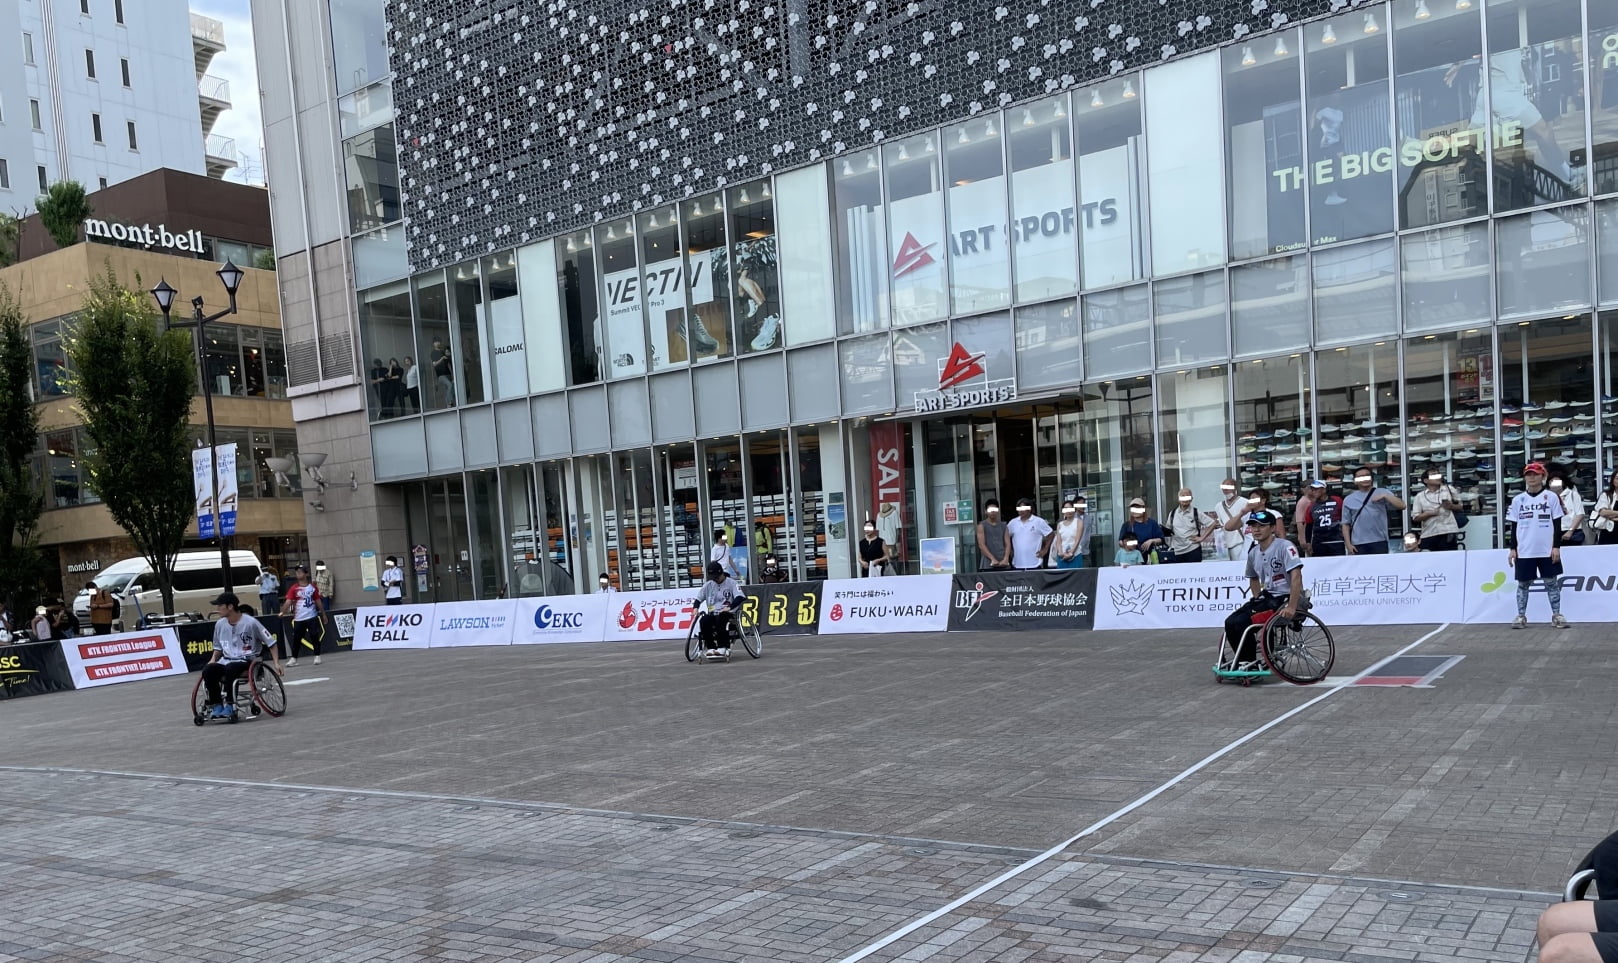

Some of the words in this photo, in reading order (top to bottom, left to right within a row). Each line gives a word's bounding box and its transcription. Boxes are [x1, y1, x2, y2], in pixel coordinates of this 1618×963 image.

[1273, 159, 1334, 193] THE
[1341, 147, 1392, 180] BIG
[1400, 120, 1524, 167] SOFTIE
[1003, 197, 1118, 246] SPORTS
[610, 307, 630, 316] Summit
[918, 396, 946, 412] ART
[947, 386, 1010, 410] SPORTS
[1318, 514, 1332, 528] 25
[1157, 577, 1187, 585] UNDER
[1189, 576, 1206, 584] THE
[1310, 572, 1447, 597] 植草学園大学
[1000, 592, 1088, 608] 全日本野球協会
[1157, 585, 1251, 602] TRINITY
[1341, 598, 1375, 606] GAKUEN
[1376, 596, 1422, 606] UNIVERSITY
[998, 610, 1024, 618] Baseball
[1060, 609, 1068, 617] of
[1068, 609, 1087, 618] Japan
[1165, 604, 1204, 613] TOKYO
[439, 616, 490, 631] LAWSON
[371, 630, 409, 642] BALL
[101, 642, 132, 654] FRONTIER
[131, 640, 157, 650] League
[108, 663, 139, 675] FRONTIER
[138, 660, 164, 671] League
